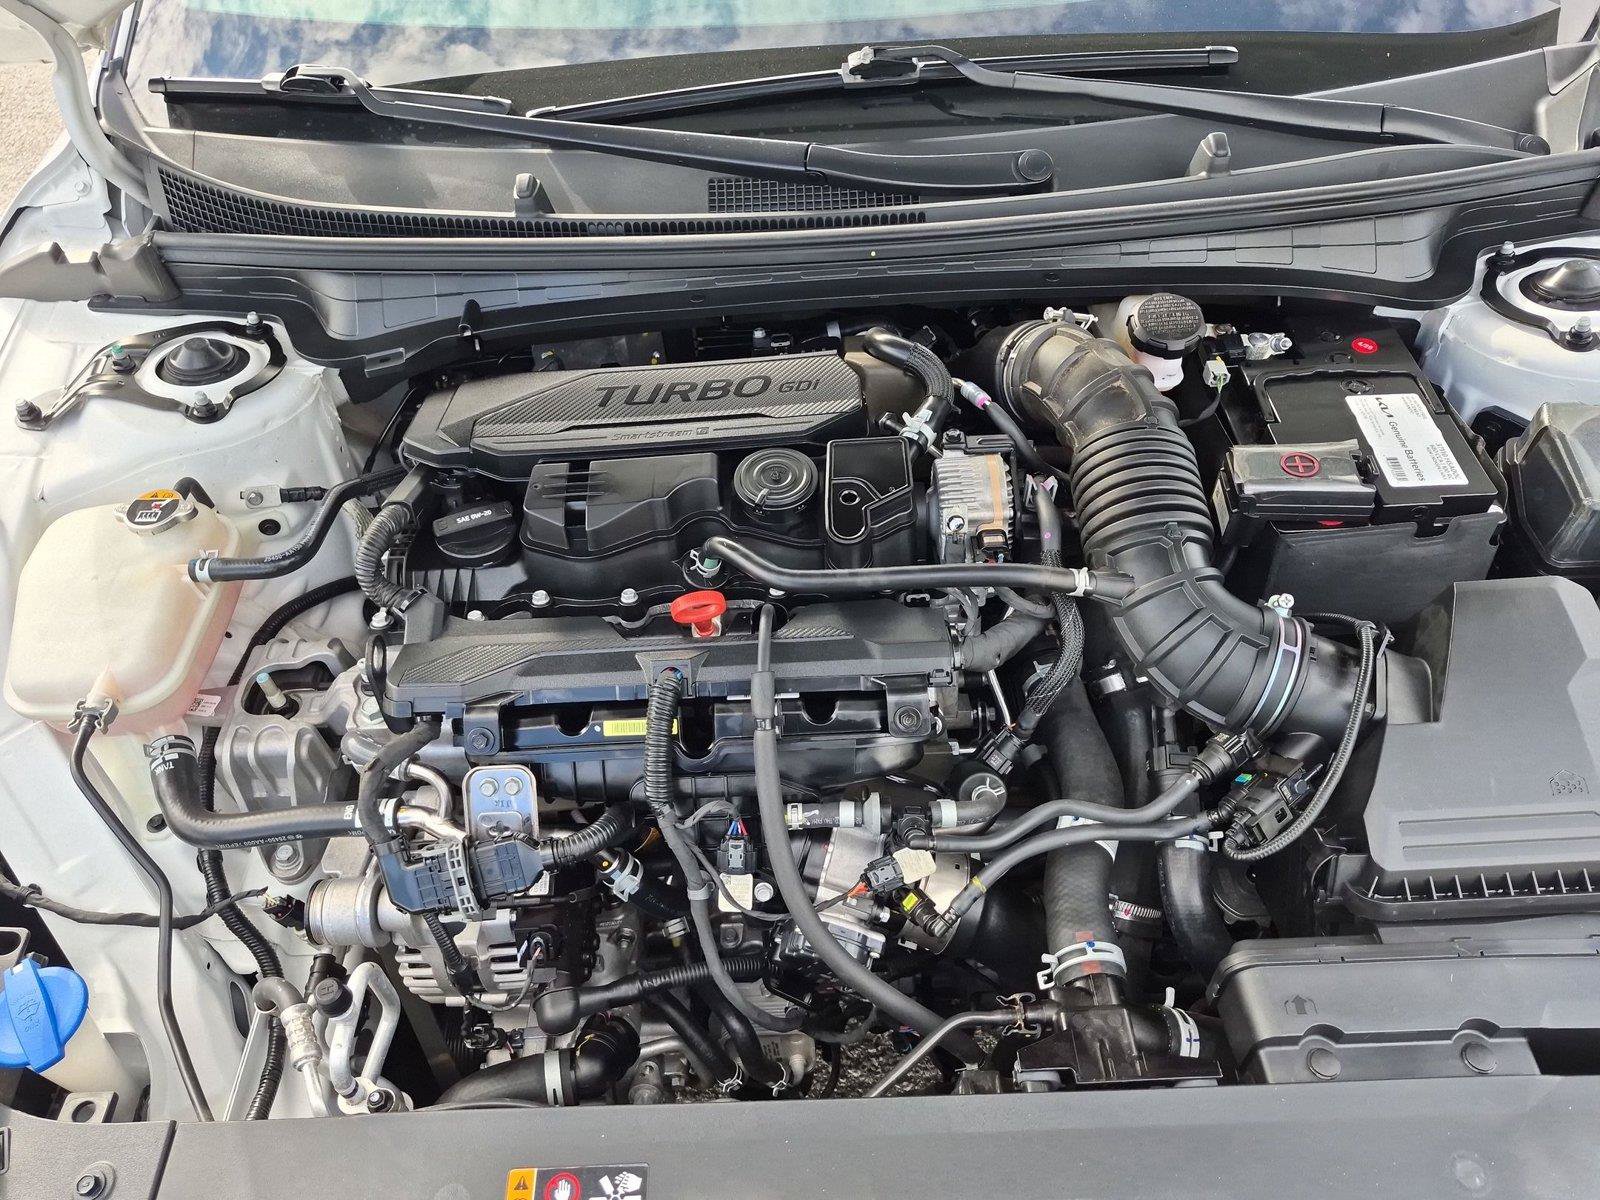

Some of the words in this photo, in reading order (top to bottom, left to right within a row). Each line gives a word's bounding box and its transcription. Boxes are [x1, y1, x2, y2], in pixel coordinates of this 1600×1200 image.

[595, 375, 772, 408] TURBO
[778, 378, 820, 393] GDi
[611, 429, 693, 441] Smartstream
[1388, 421, 1408, 449] Genuine
[1404, 449, 1426, 482] Batteries
[456, 515, 471, 524] SAE
[470, 509, 492, 520] 0W-20
[154, 761, 175, 776] TANK
